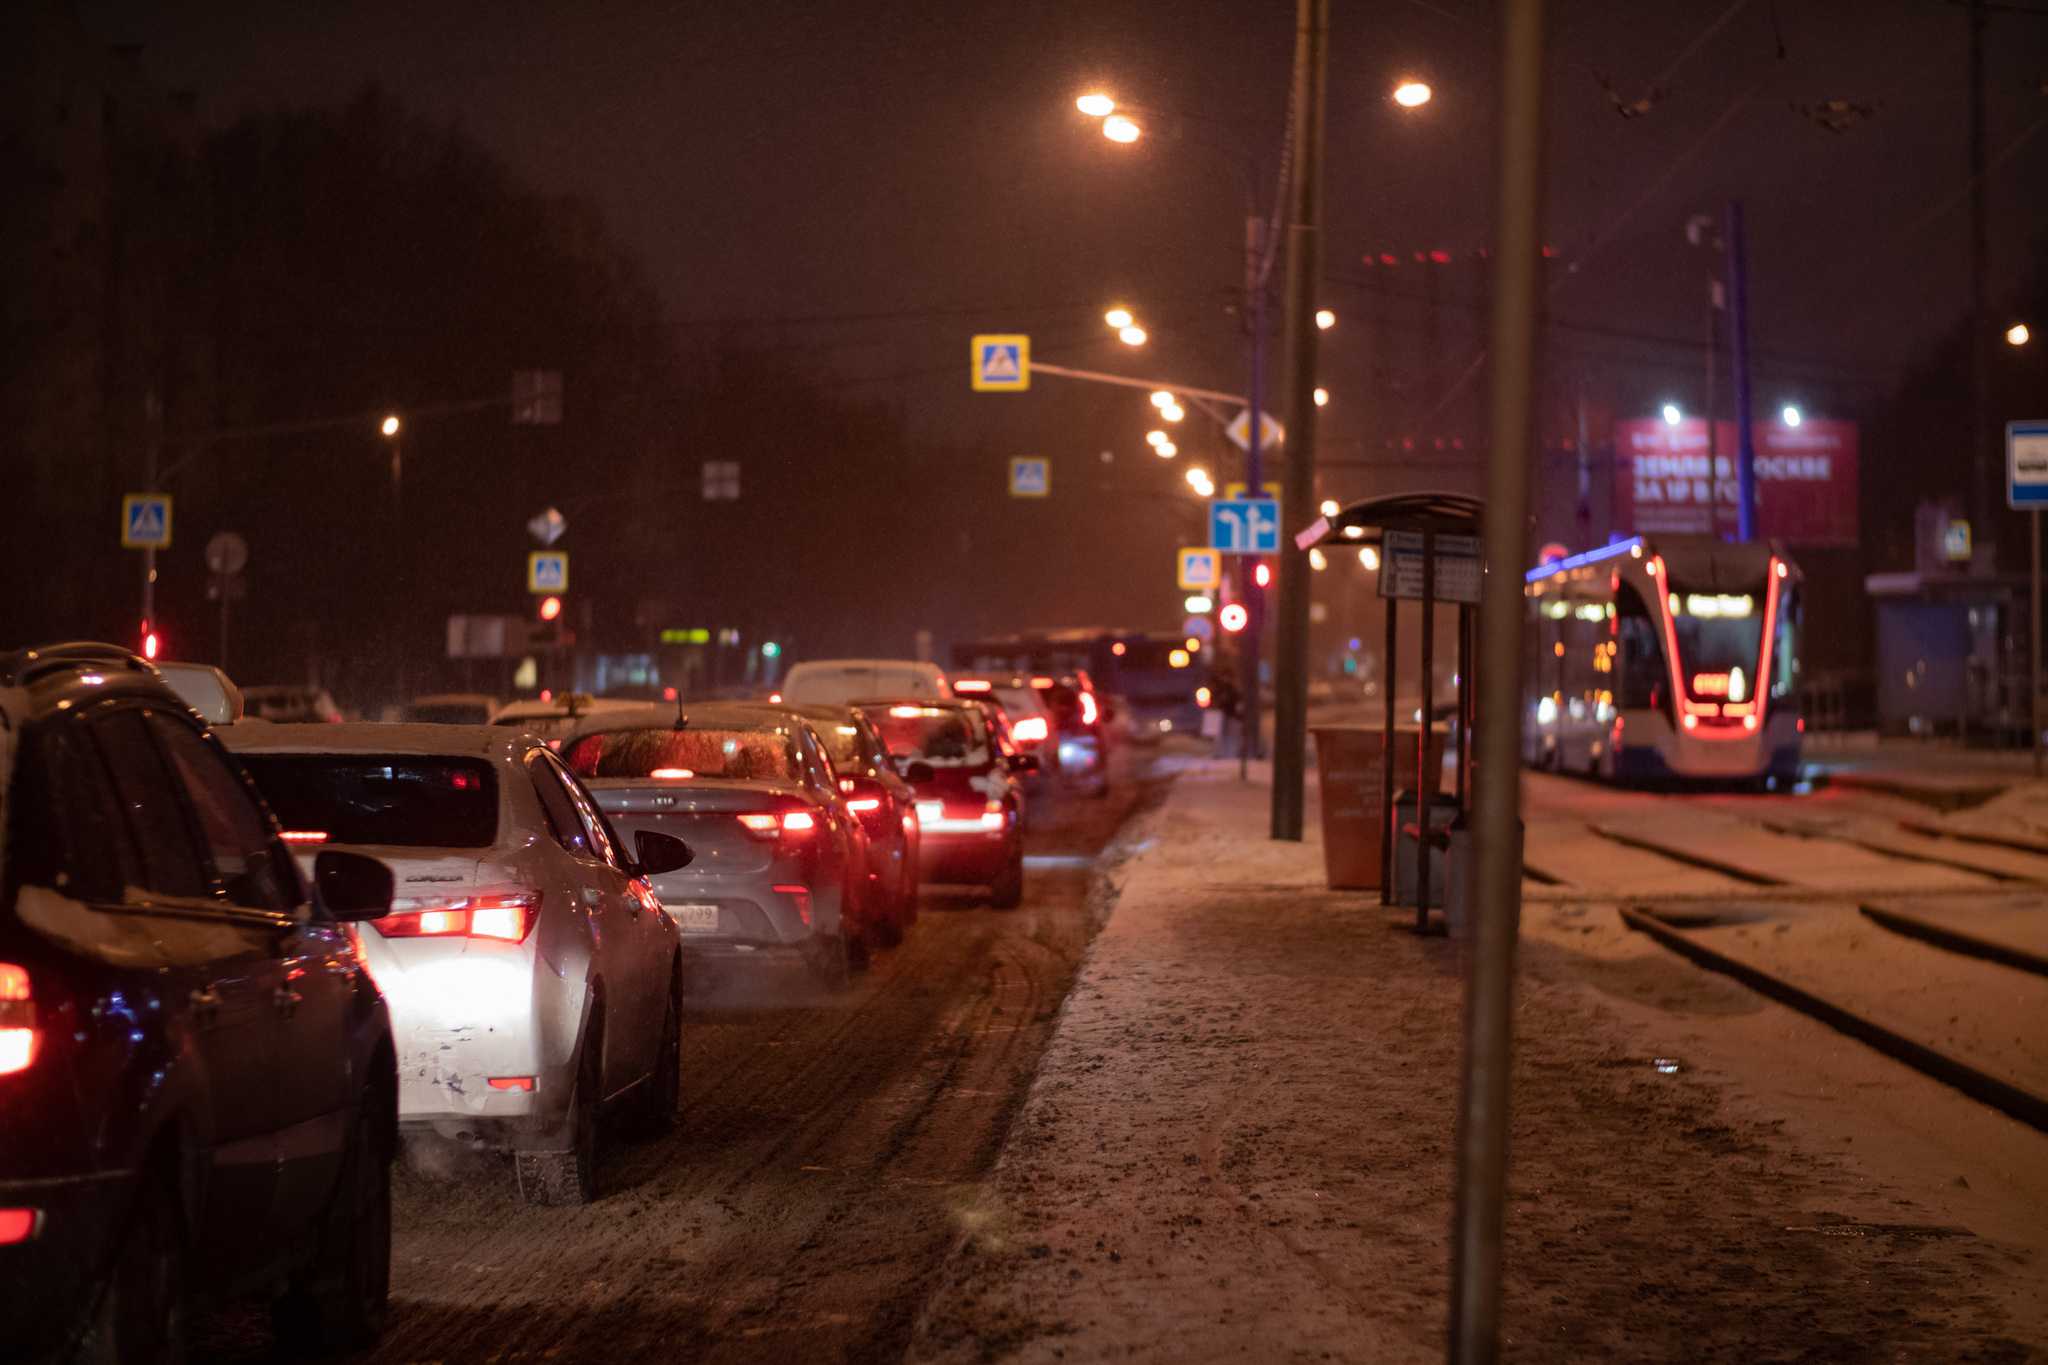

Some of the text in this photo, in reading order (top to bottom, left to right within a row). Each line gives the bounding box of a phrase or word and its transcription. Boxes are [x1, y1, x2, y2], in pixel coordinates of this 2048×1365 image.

[1633, 456, 1710, 478] ЗЕМЛЯ
[1736, 456, 1831, 480] ОСКВЕ
[1633, 479, 1663, 501] ЗА
[687, 907, 713, 920] 799
